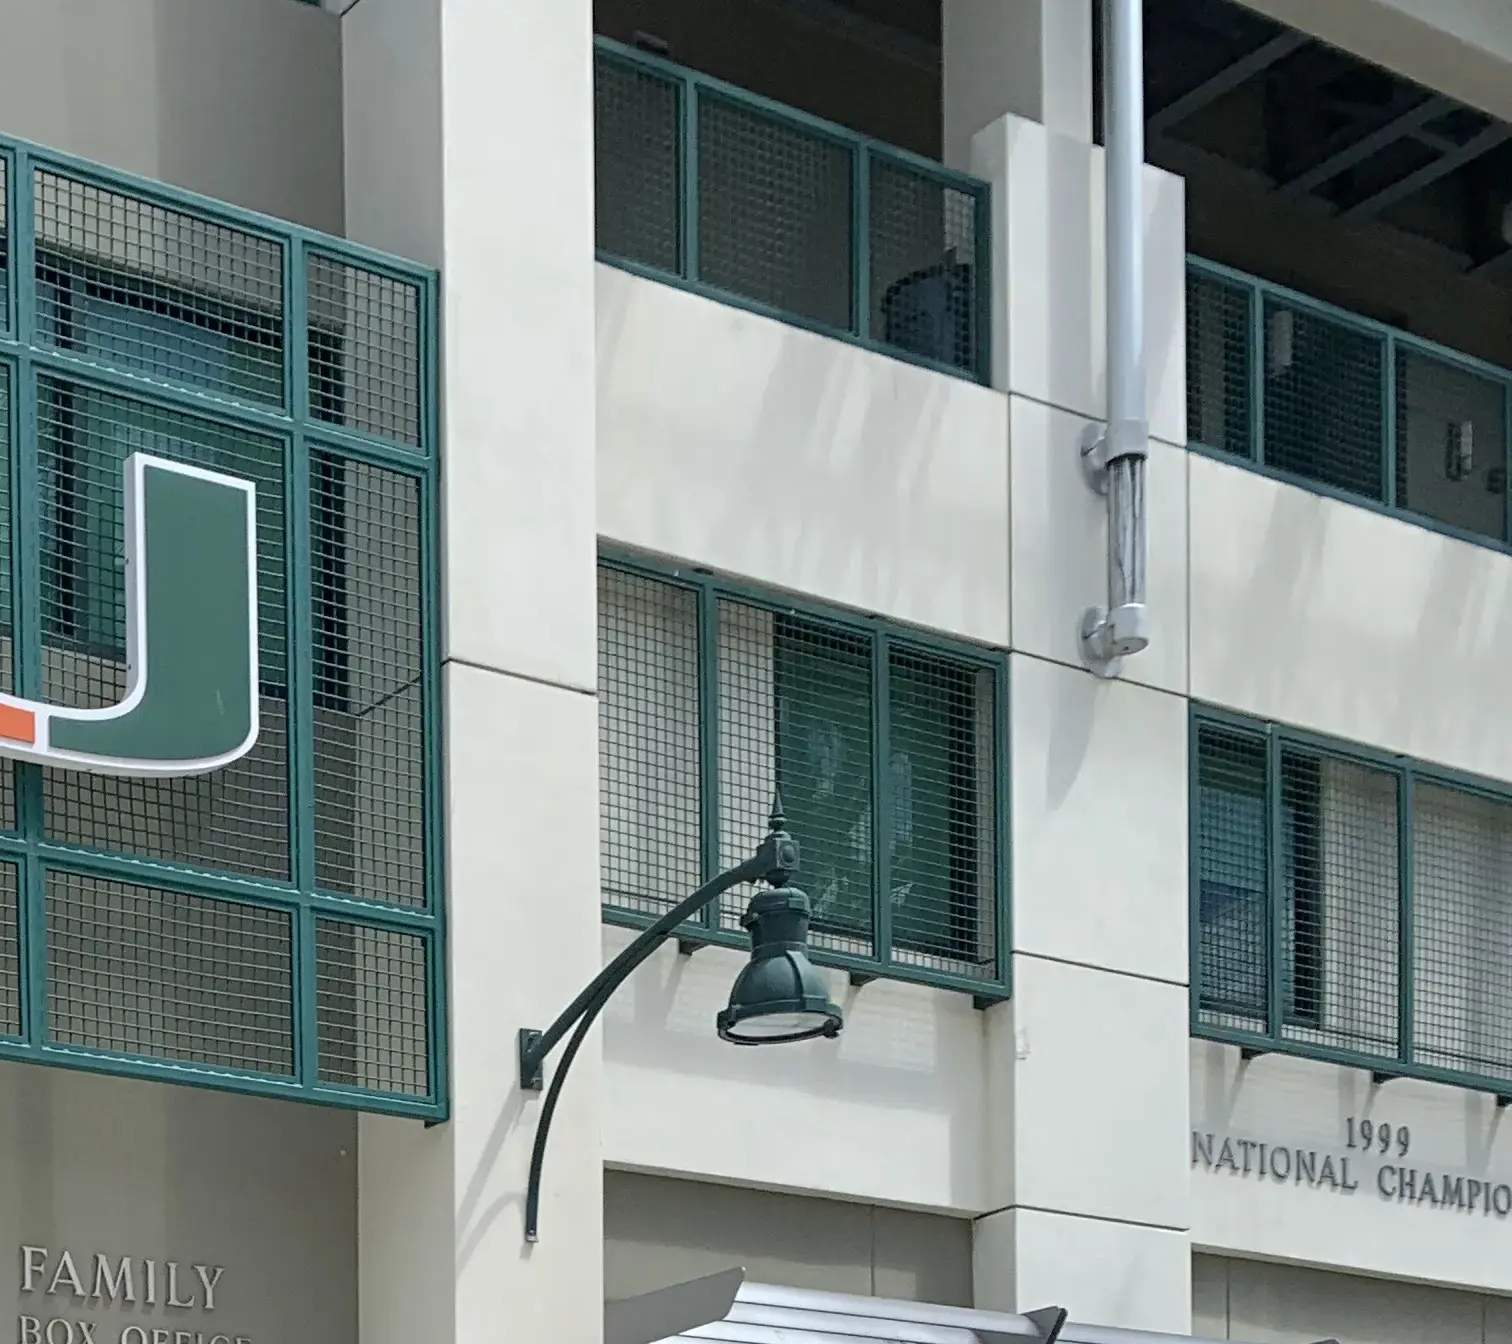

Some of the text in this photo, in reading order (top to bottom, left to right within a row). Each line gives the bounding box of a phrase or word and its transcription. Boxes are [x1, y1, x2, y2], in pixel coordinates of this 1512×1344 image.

[1191, 1130, 1358, 1192] NATIONAL
[1346, 1116, 1410, 1157] 1999
[20, 1245, 226, 1310] FAMILY
